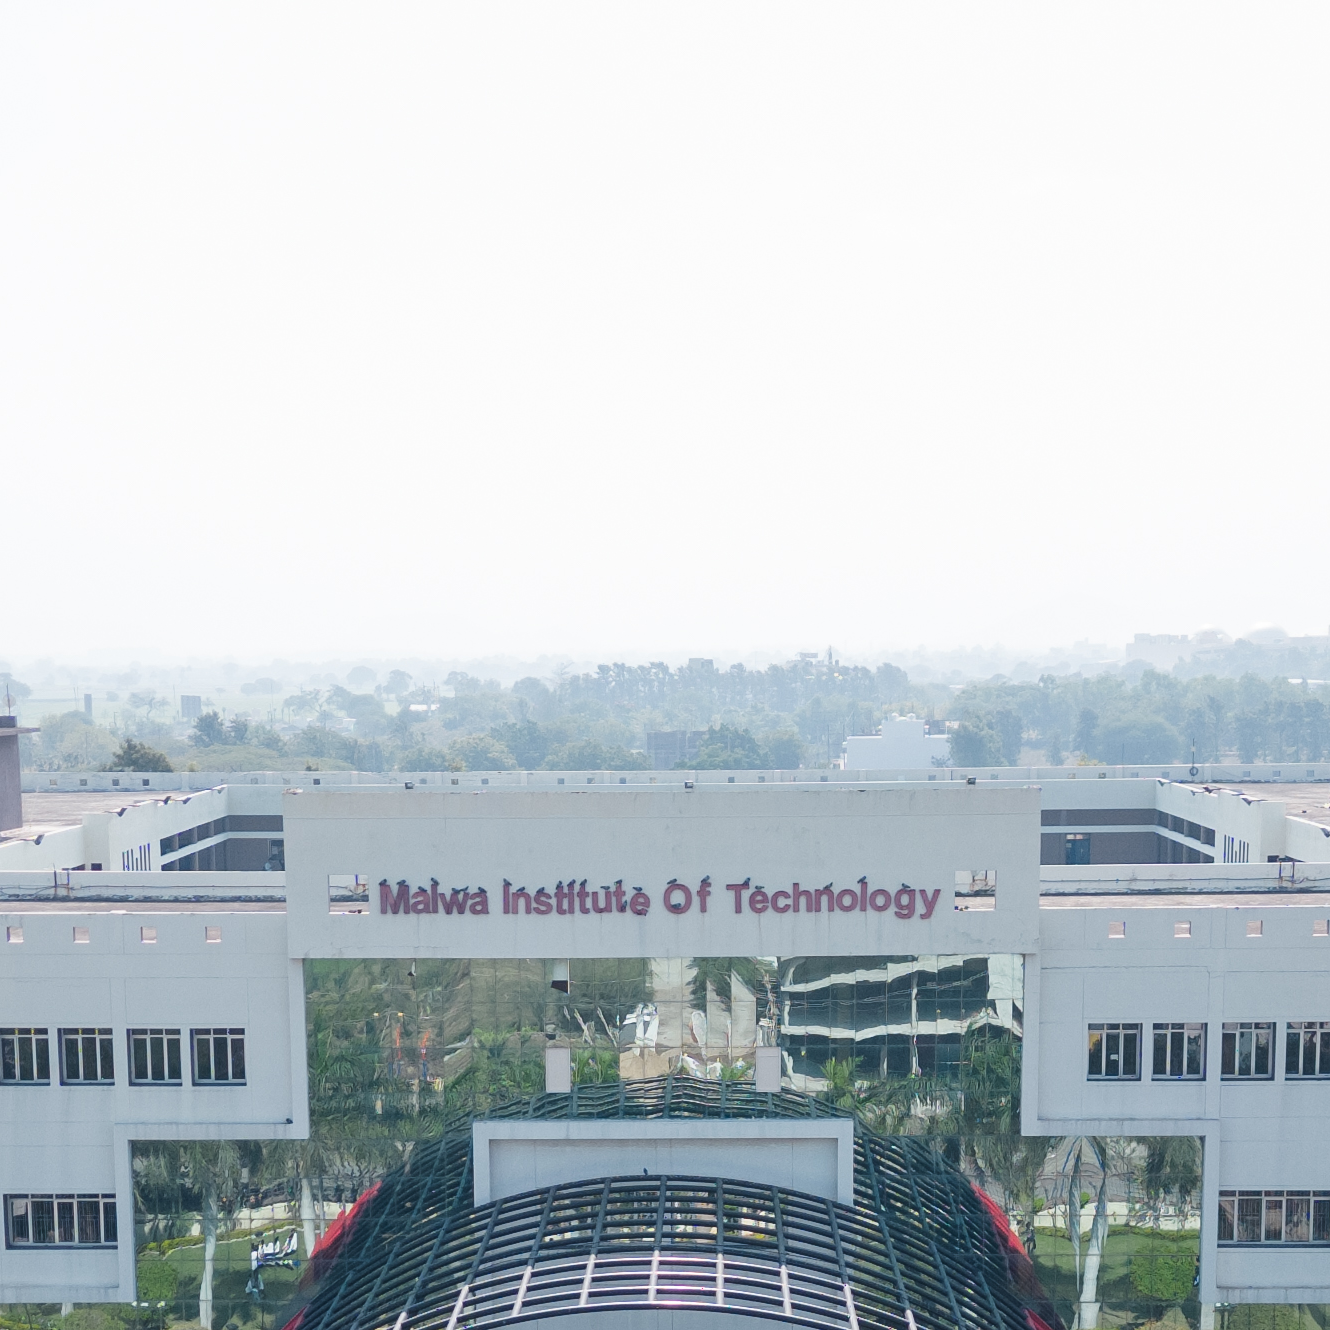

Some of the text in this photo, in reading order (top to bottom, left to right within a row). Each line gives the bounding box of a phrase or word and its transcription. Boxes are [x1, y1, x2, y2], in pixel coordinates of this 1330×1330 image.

[379, 882, 942, 920] Malwa Institute Of Technology
